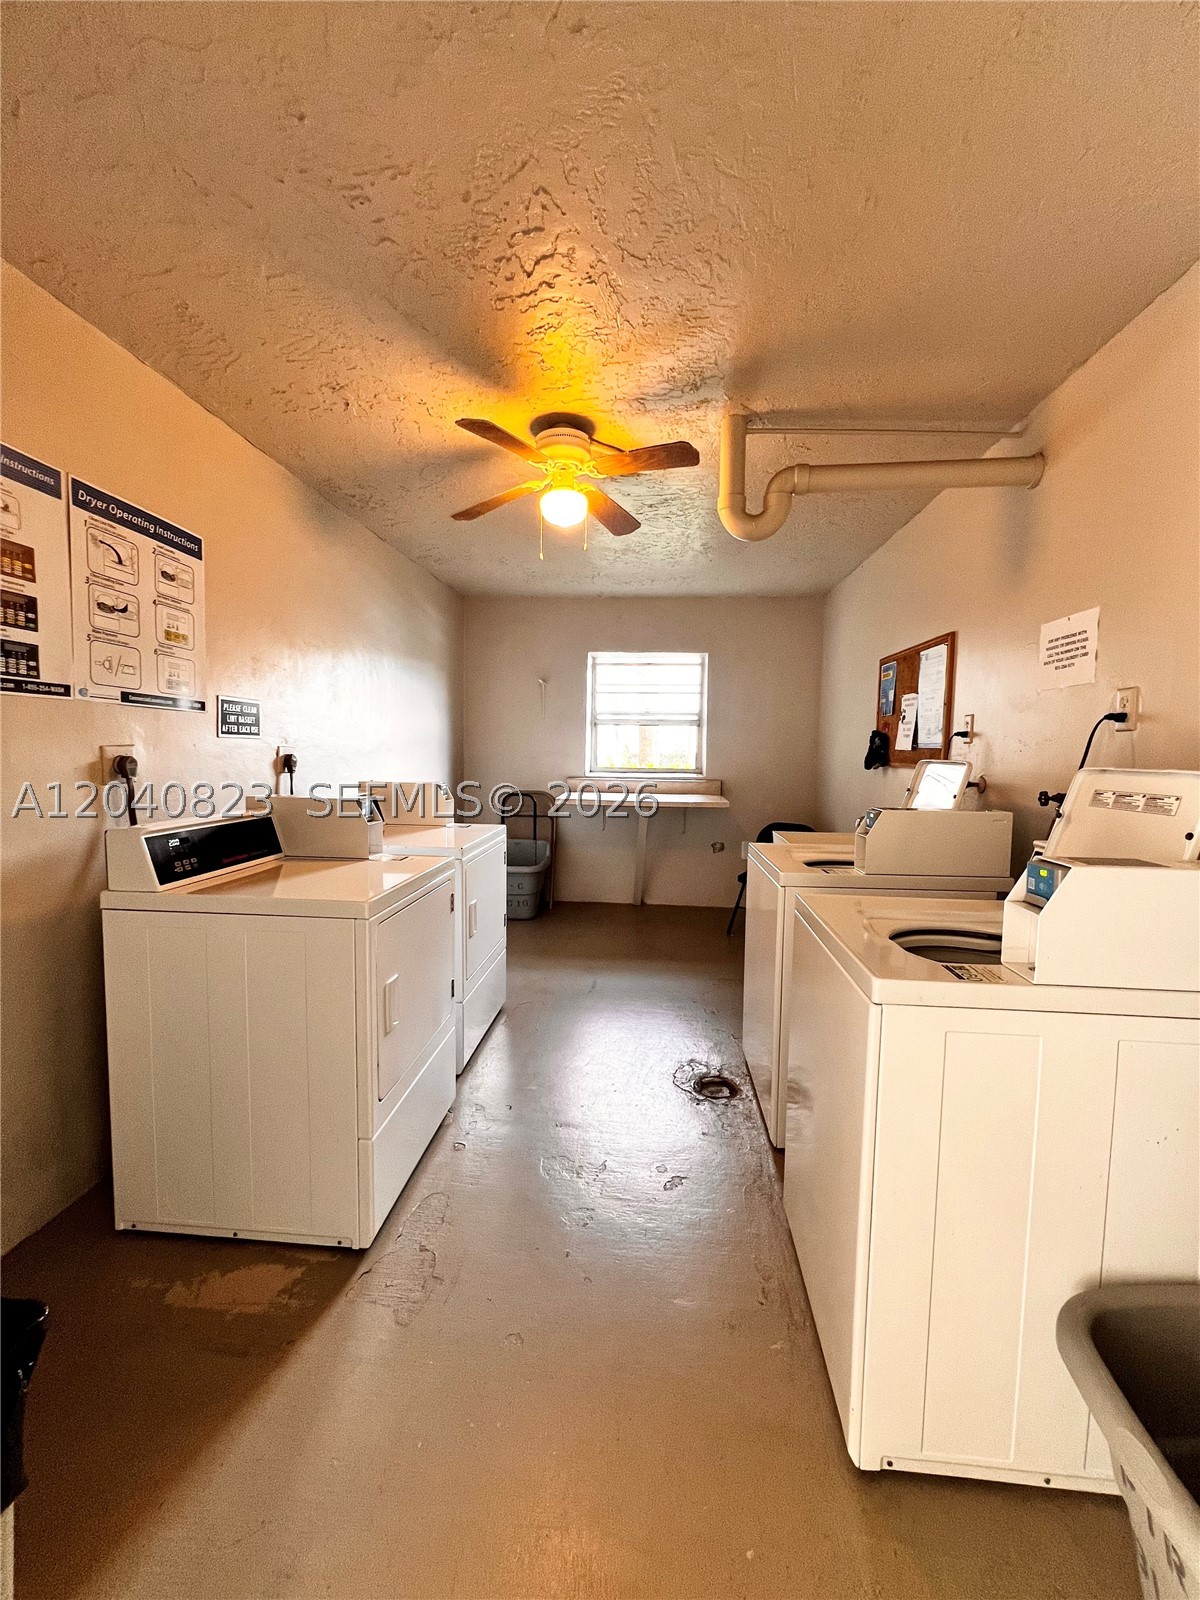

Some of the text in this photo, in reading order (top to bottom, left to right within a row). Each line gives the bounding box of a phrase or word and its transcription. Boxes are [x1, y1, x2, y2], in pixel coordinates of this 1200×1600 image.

[78, 490, 107, 510] Dryer
[109, 504, 155, 533] Operating
[156, 525, 199, 552] Instructions
[85, 576, 90, 584] 3
[223, 703, 257, 714] PLEASE CLEAR
[226, 715, 256, 724] LINT BASKET
[222, 724, 238, 733] AFTER
[251, 726, 259, 734] USE
